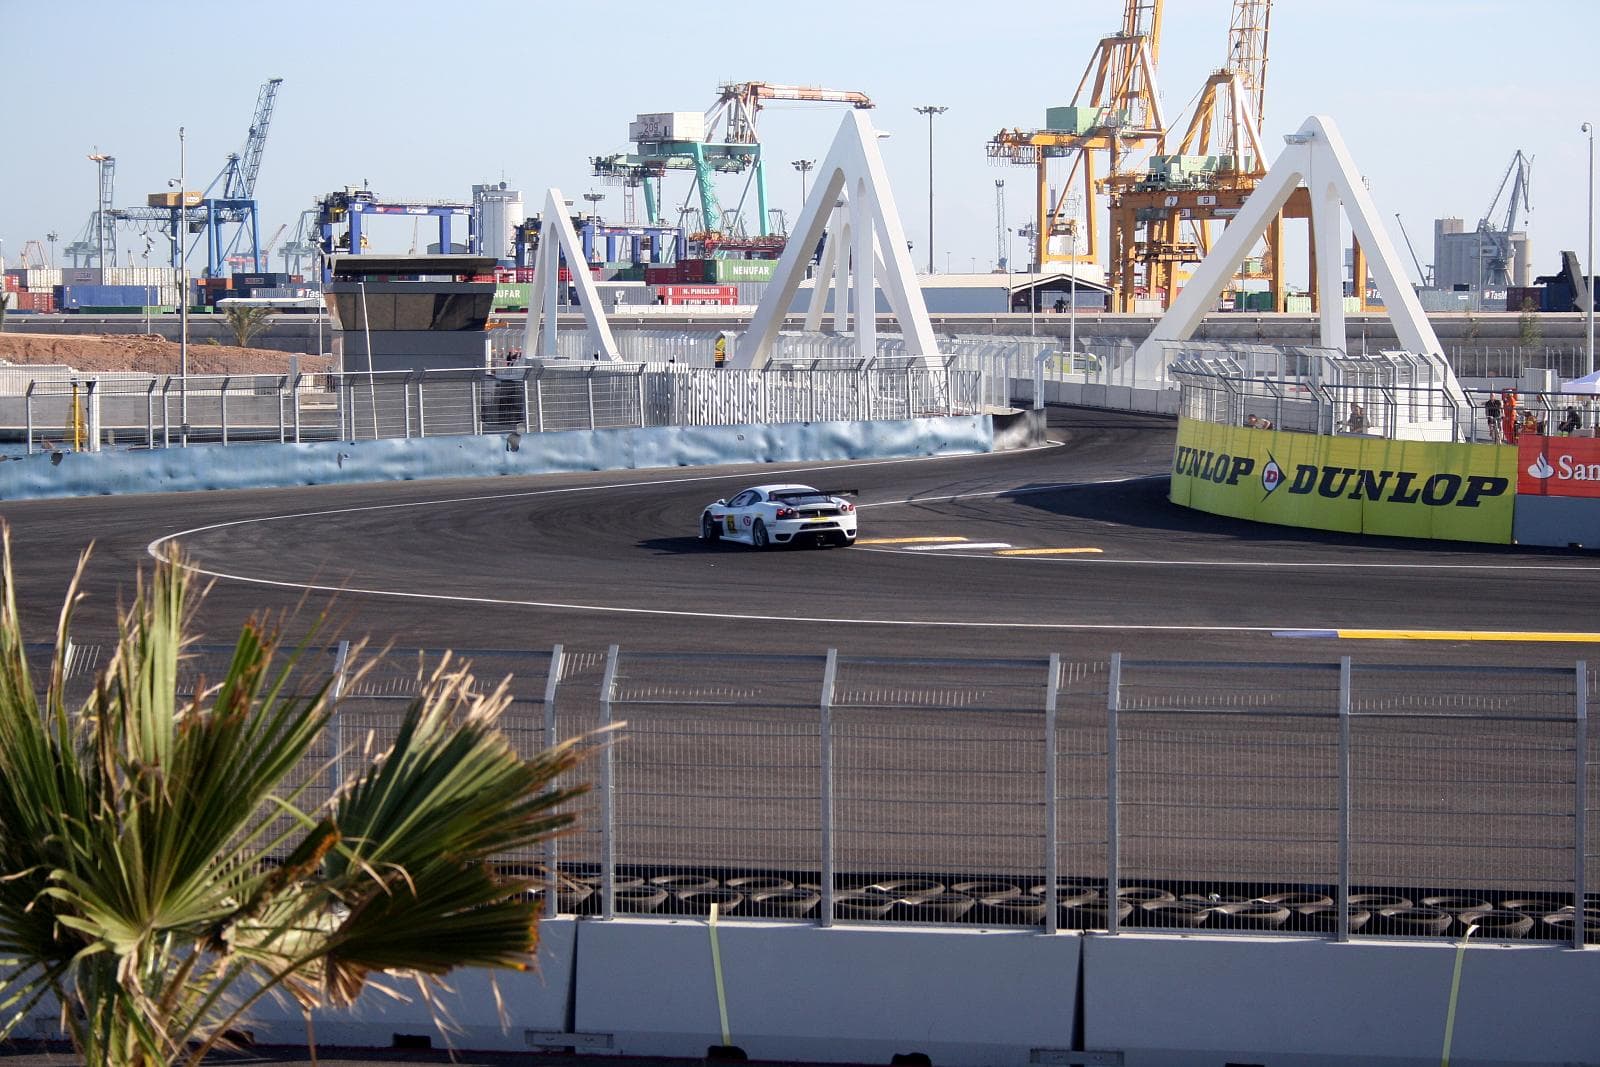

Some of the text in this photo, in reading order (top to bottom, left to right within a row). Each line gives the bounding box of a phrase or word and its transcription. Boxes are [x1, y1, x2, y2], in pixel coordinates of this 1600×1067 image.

[644, 122, 659, 133] 209
[732, 266, 770, 275] NENUFAR
[1288, 464, 1509, 508] DUNLOP
